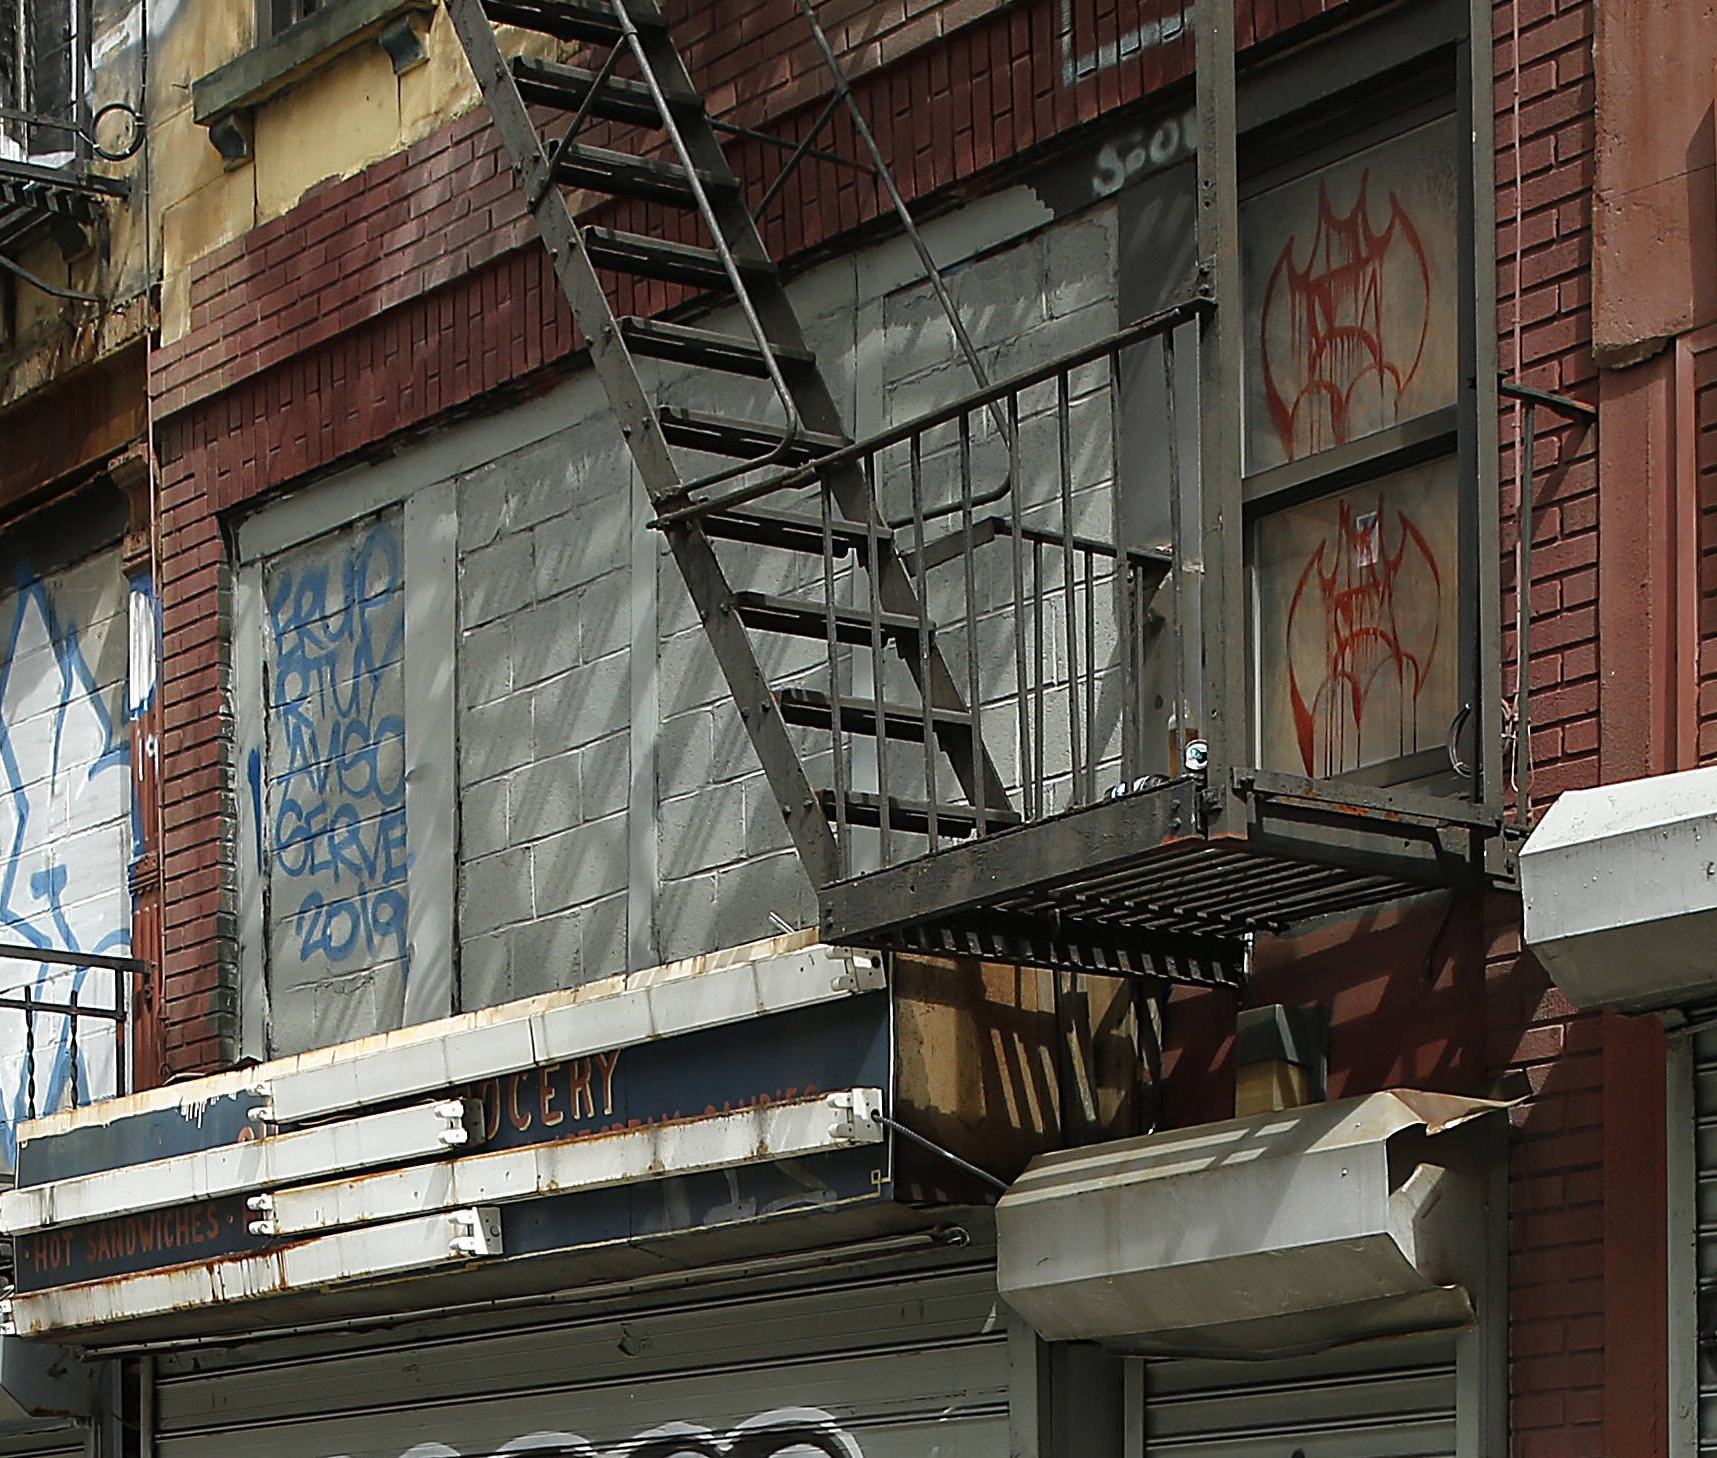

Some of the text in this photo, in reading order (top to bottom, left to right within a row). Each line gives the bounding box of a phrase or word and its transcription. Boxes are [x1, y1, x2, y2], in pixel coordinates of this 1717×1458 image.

[276, 798, 409, 884] SERVE
[295, 882, 409, 980] 2019
[34, 1230, 74, 1272] HOT
[86, 1203, 220, 1262] SANDWICHES
